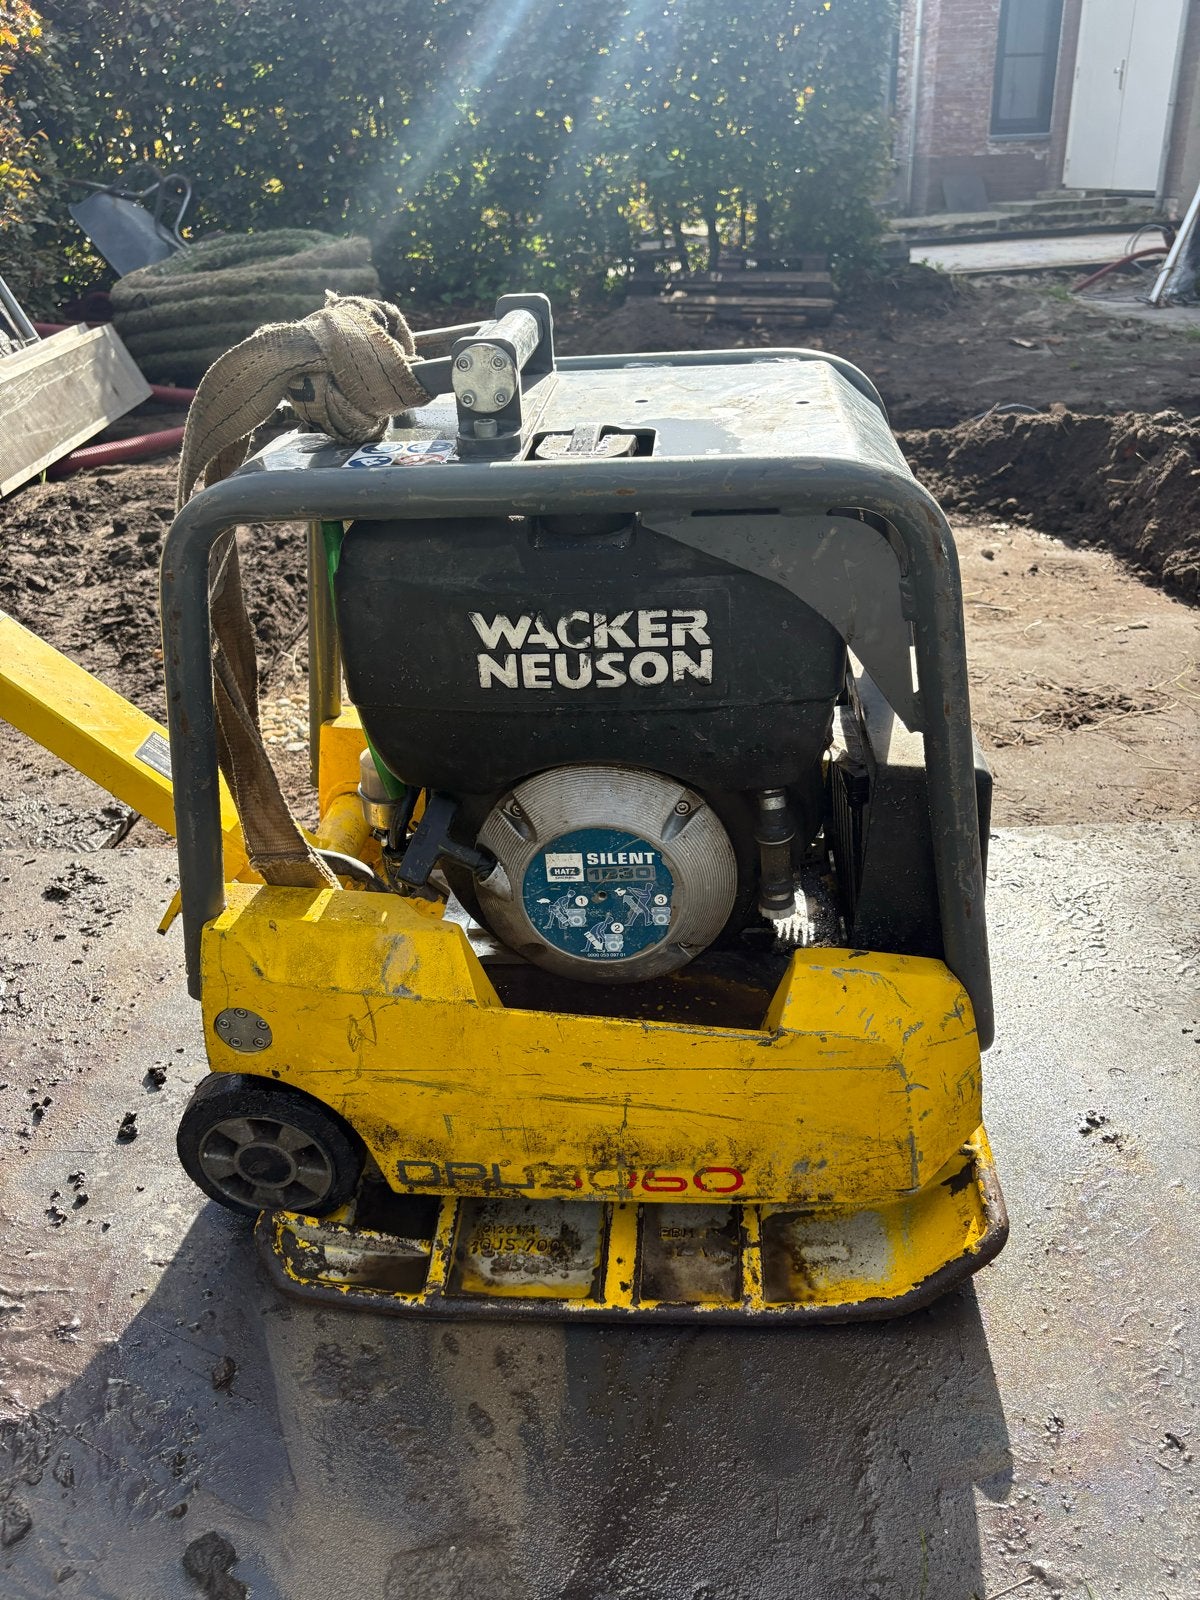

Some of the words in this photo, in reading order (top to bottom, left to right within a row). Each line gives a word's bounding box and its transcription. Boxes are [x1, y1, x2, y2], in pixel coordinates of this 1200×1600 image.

[468, 609, 711, 649] WACKER
[477, 649, 713, 689] NEUSON
[554, 867, 577, 876] HATZ
[587, 852, 655, 865] SILENT
